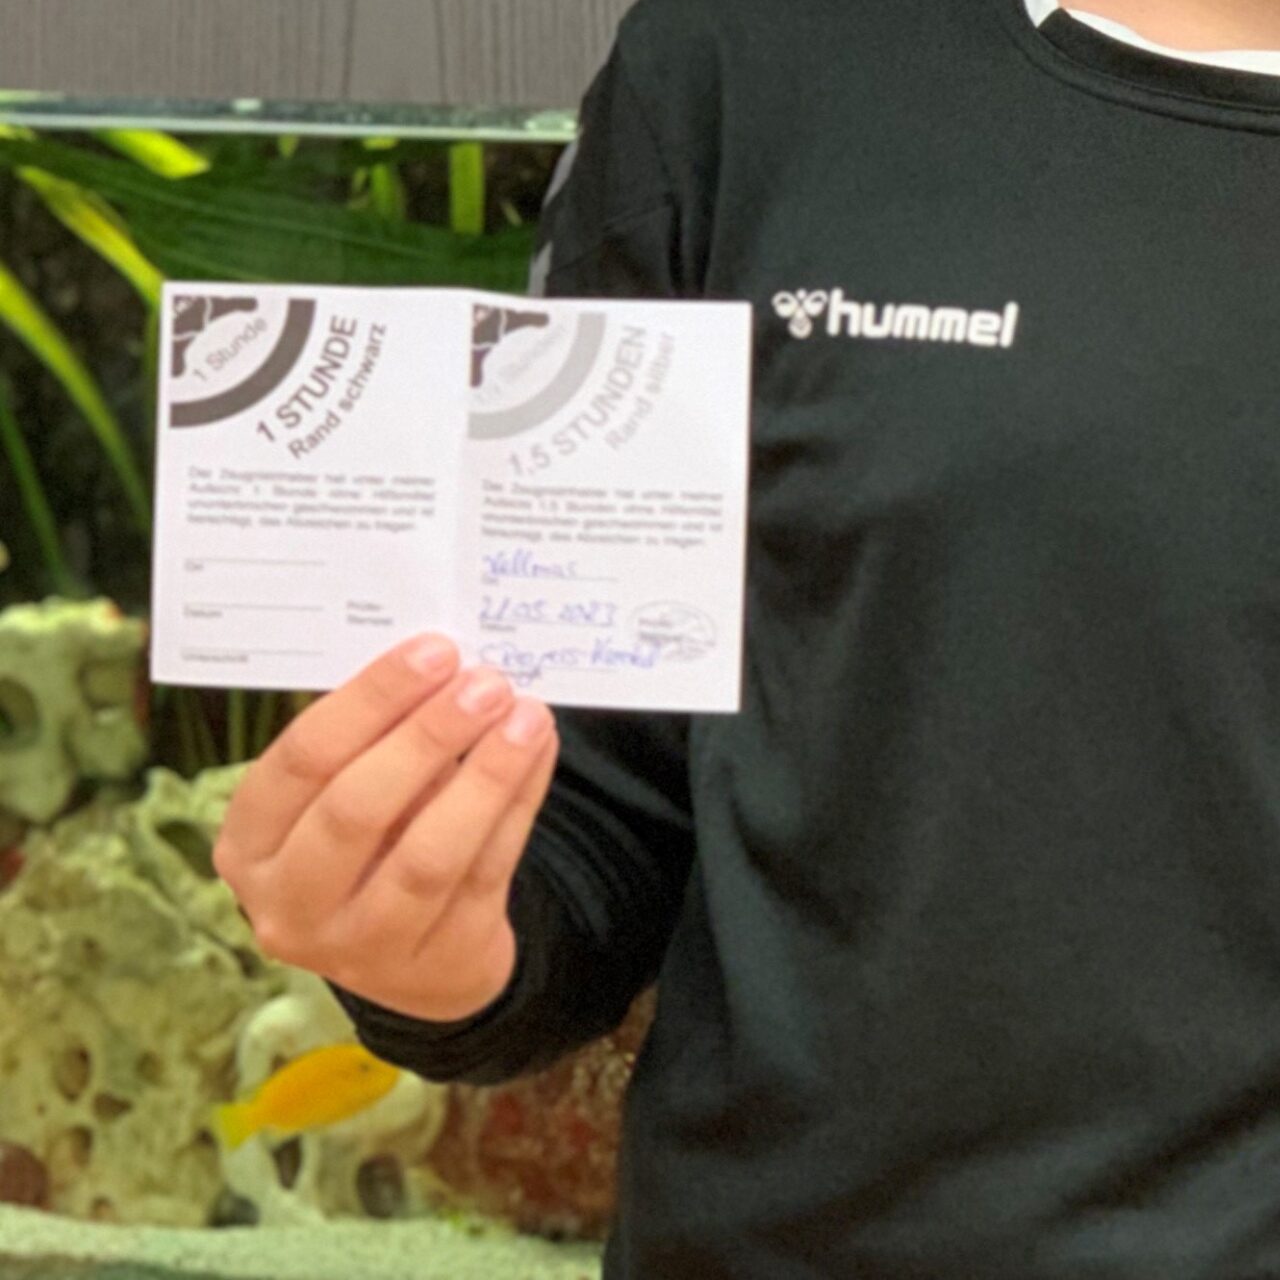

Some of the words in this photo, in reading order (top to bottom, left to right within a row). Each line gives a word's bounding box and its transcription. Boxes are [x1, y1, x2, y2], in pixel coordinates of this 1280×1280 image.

[205, 317, 269, 372] Stunde
[826, 287, 1019, 348] hummel
[256, 420, 278, 443] 1
[275, 315, 358, 430] STUNDE
[287, 410, 342, 459] Rand
[338, 322, 388, 413] schwarz
[551, 324, 648, 457] STUNDEN
[604, 395, 654, 451] Rand
